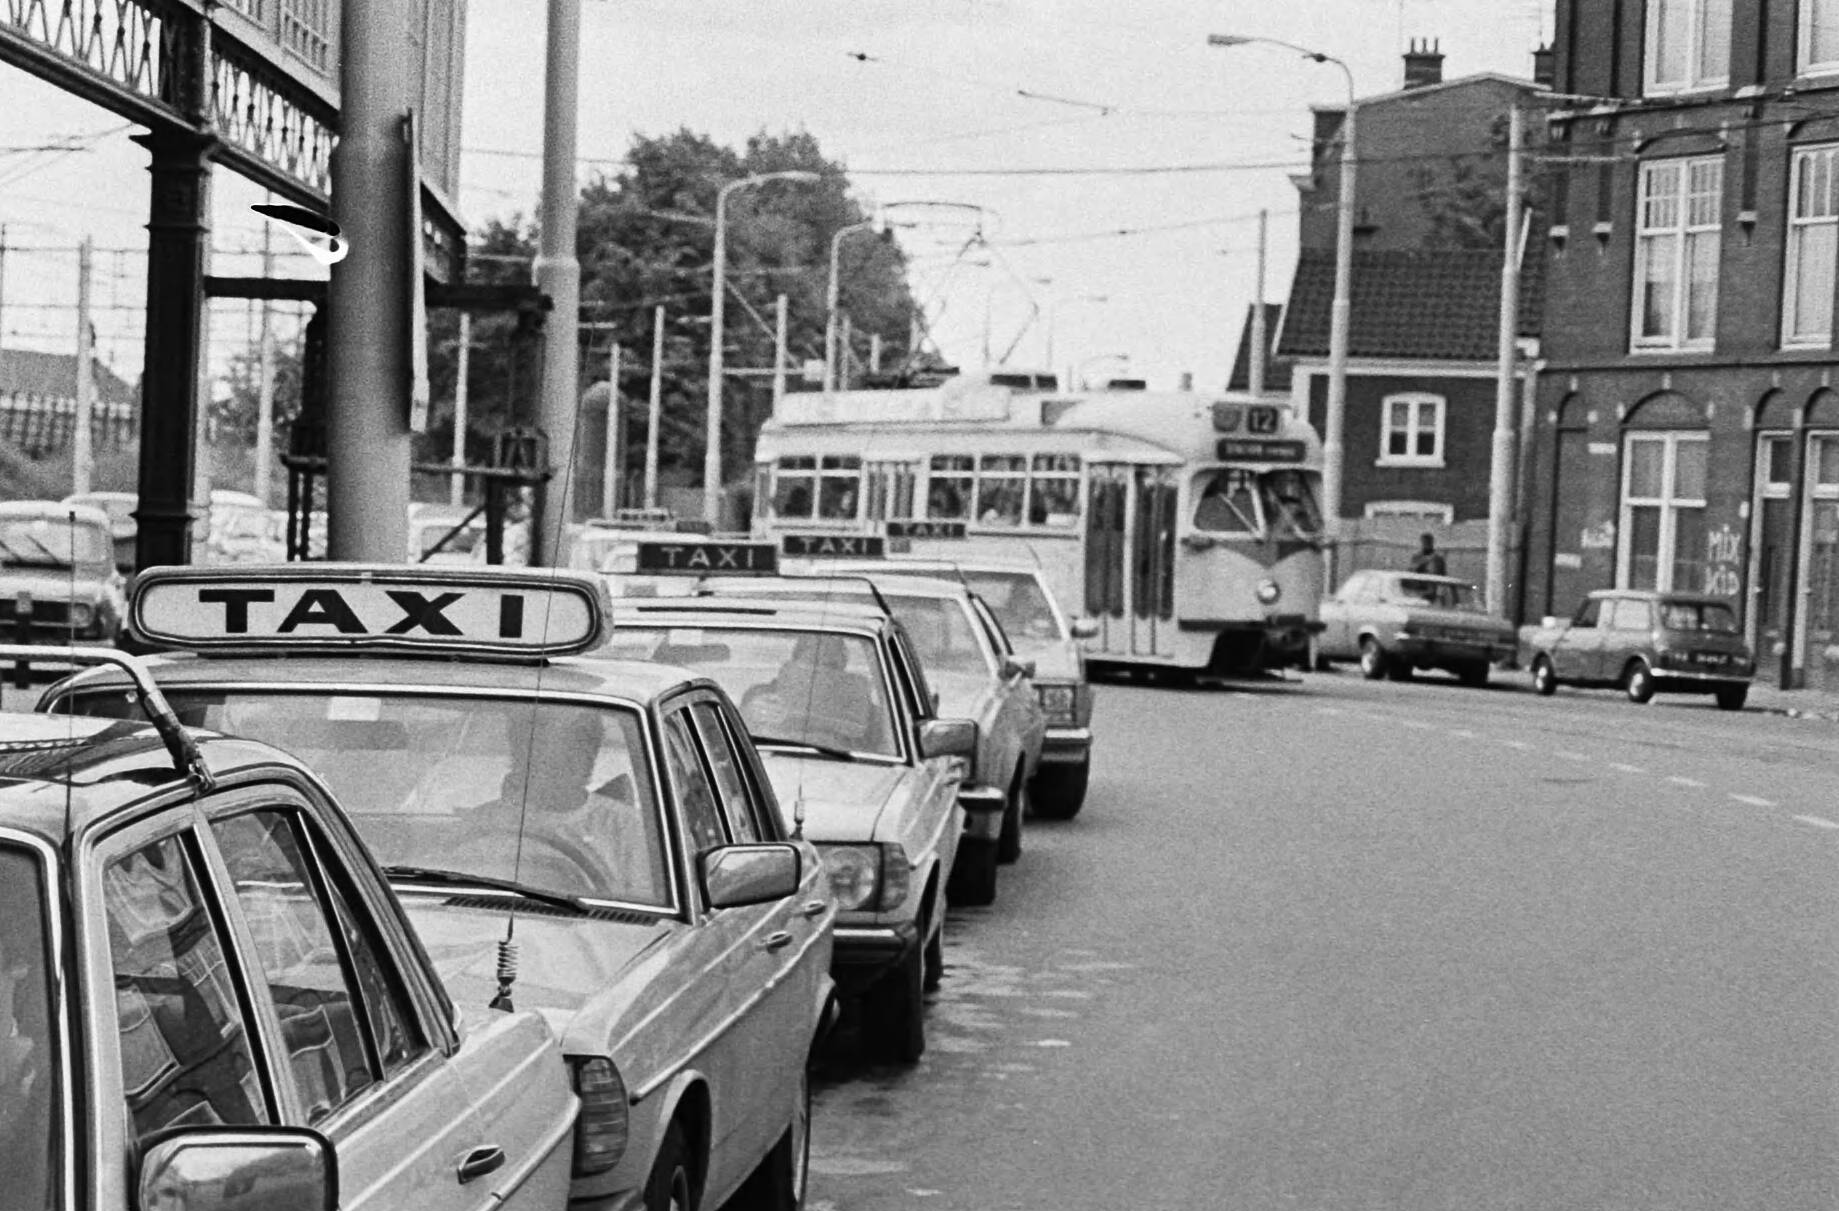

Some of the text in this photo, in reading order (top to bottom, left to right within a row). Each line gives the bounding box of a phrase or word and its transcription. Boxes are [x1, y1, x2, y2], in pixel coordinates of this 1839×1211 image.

[1252, 409, 1274, 431] 12
[801, 537, 869, 555] TAXI
[661, 547, 754, 568] TAXI
[198, 588, 525, 638] TAXI
